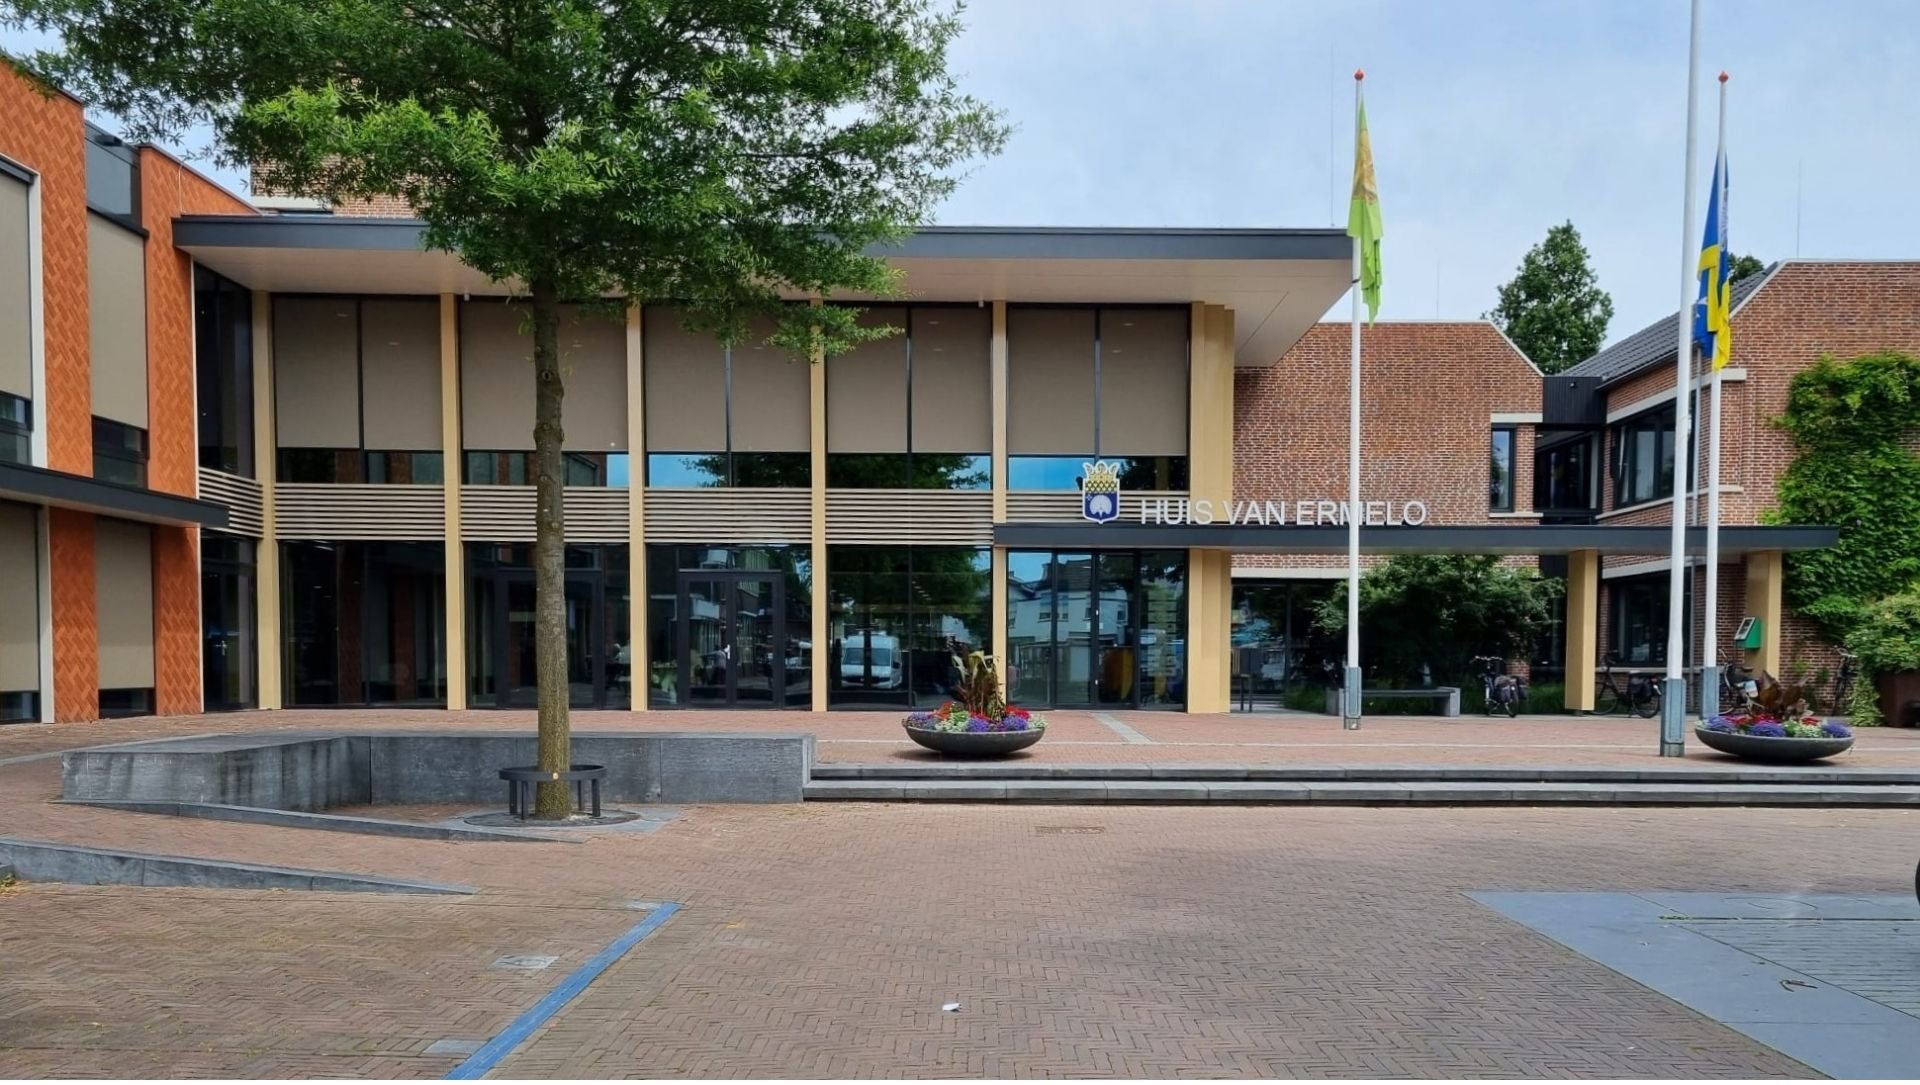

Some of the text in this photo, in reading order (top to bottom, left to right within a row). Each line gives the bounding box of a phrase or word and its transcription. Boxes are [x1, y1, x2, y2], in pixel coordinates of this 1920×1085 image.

[1141, 500, 1427, 526] HUIS VAN ERMELO
